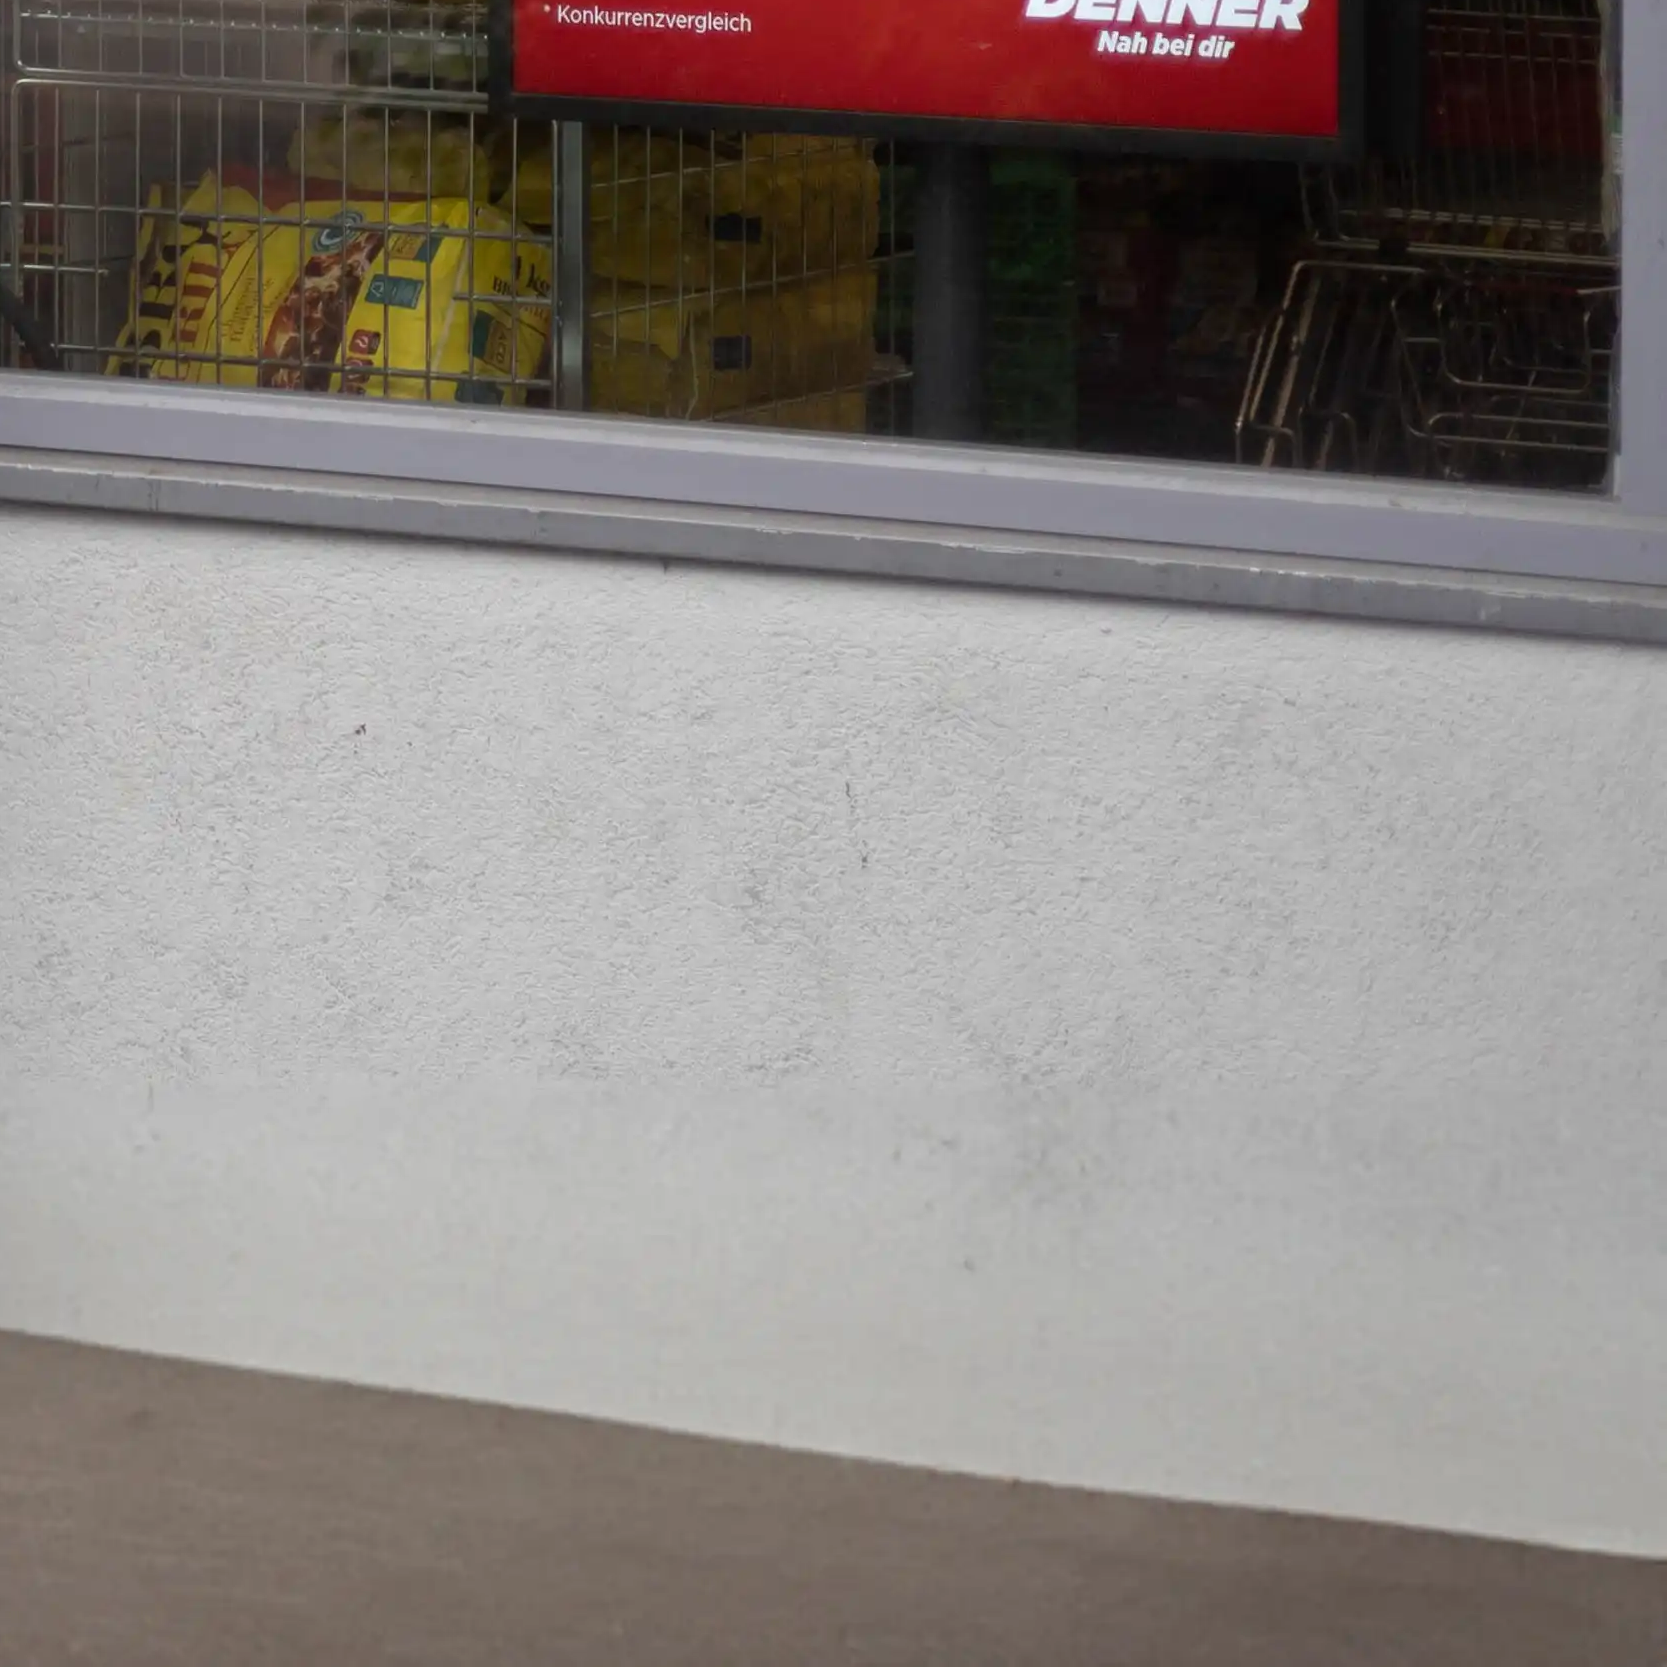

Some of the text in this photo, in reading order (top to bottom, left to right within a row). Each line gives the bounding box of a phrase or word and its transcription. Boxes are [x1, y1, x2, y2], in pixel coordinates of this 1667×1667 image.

[557, 3, 752, 34] Konkurrenzvergleich
[1097, 30, 1235, 58] Nah bei dir
